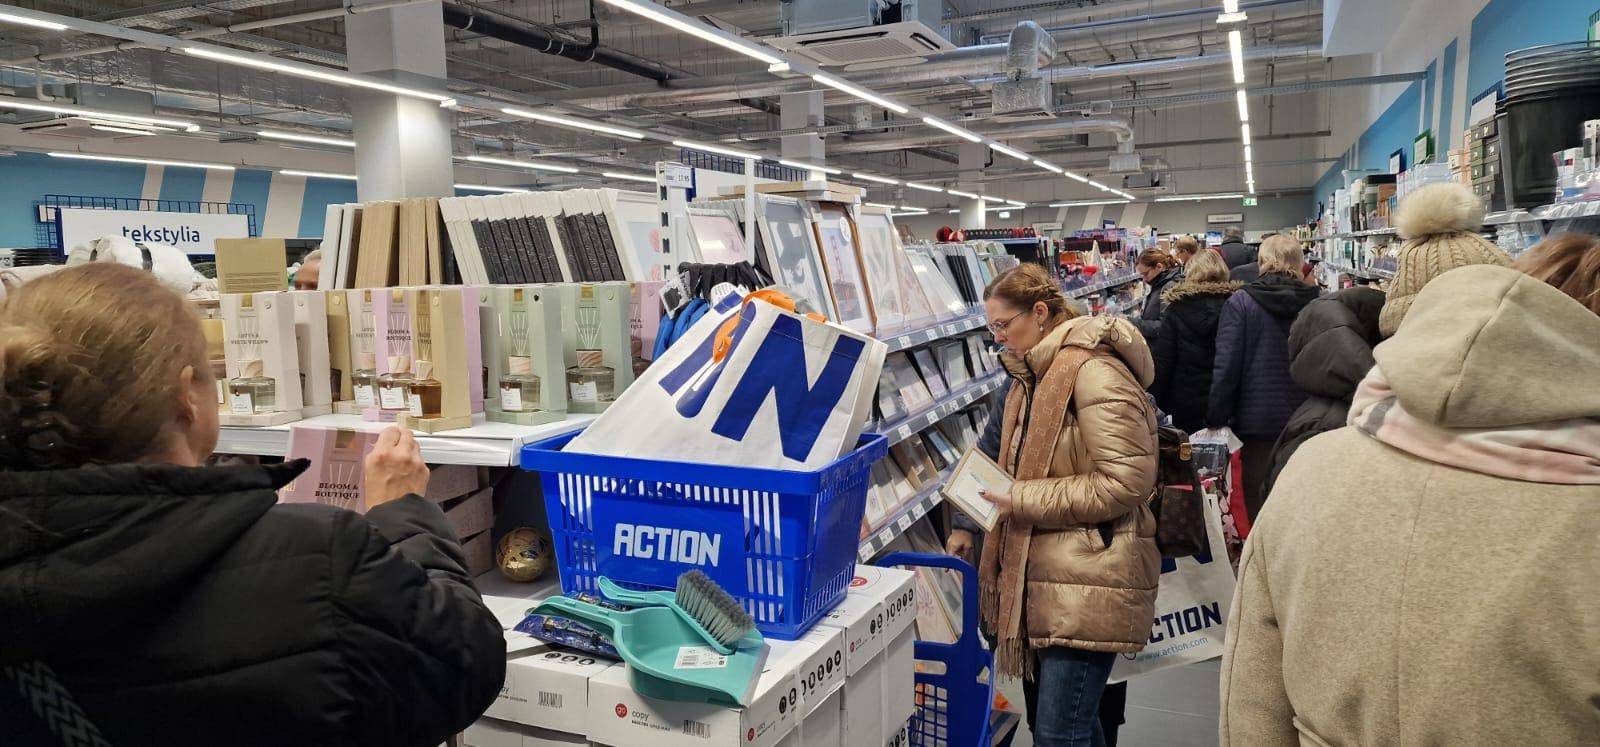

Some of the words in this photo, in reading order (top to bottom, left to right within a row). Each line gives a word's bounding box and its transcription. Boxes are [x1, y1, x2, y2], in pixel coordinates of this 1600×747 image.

[122, 224, 201, 246] tekstylia
[318, 482, 351, 490] BLOOM
[315, 490, 360, 500] BOUTIQUE
[613, 522, 721, 568] ACTION
[1144, 601, 1223, 646] CTION
[631, 710, 650, 722] copy
